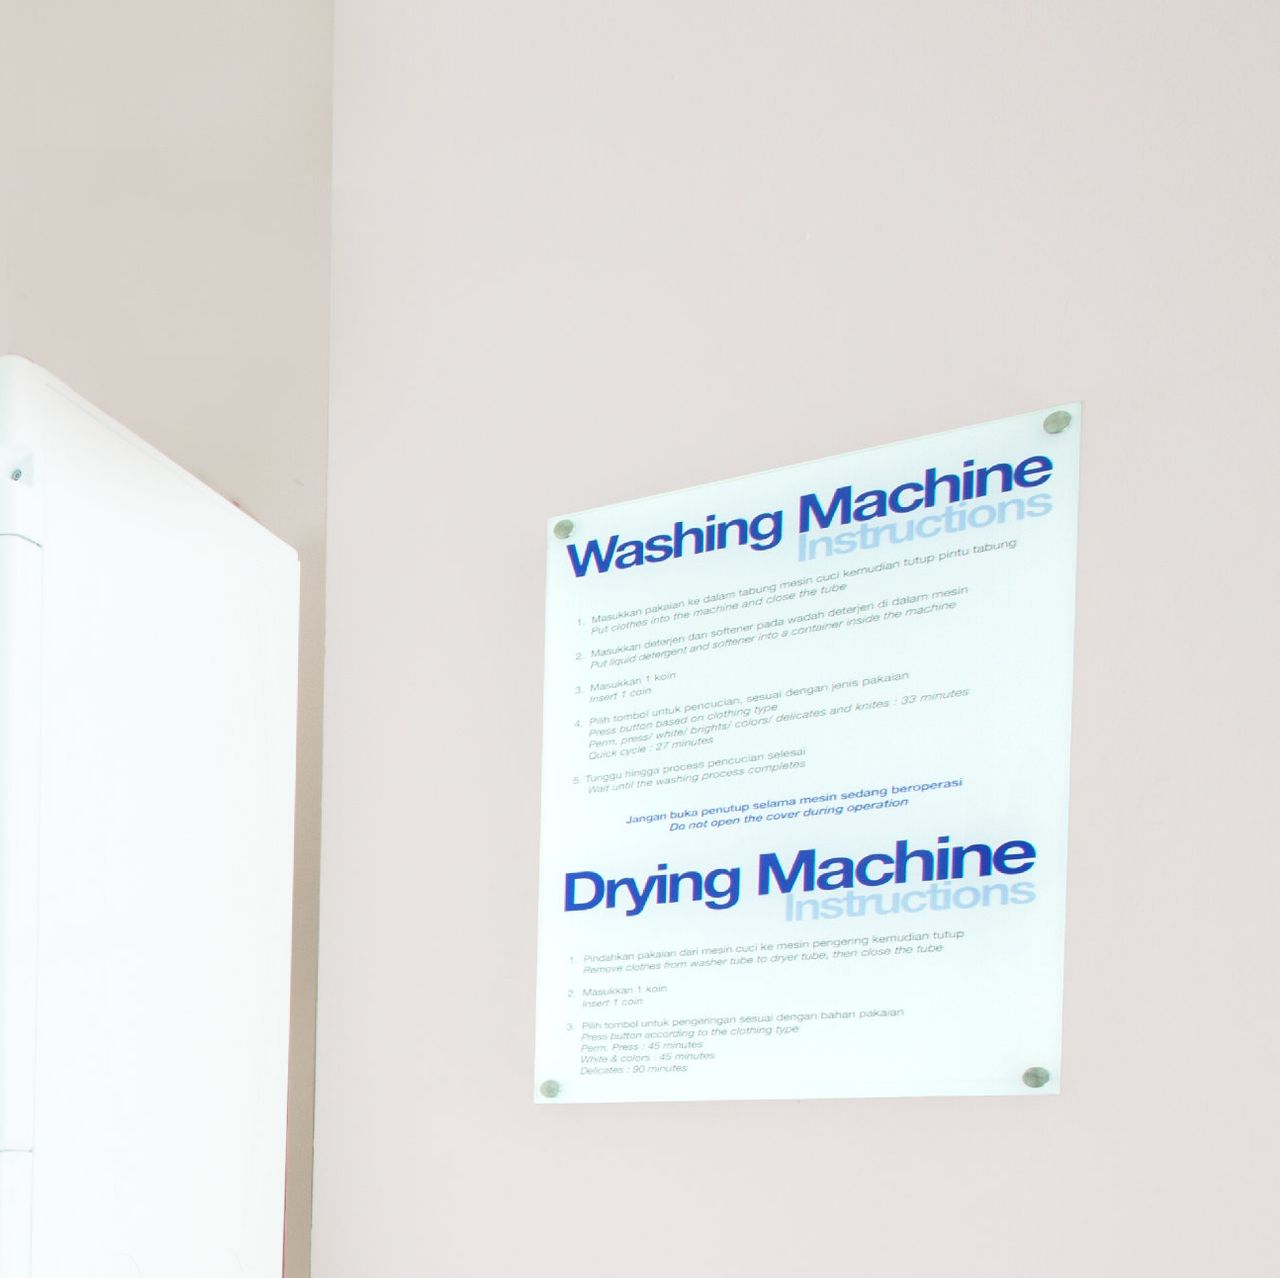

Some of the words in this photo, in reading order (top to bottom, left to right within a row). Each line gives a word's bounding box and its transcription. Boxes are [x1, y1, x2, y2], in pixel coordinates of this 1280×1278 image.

[567, 509, 784, 577] Washing
[799, 454, 1054, 533] Machine
[799, 490, 1053, 561] Instructions
[591, 608, 642, 624] Masukkan
[644, 600, 685, 615] pakaian
[687, 598, 701, 606] ke
[702, 591, 736, 604] dalam
[738, 584, 777, 597] tabung
[779, 576, 813, 589] mesin
[816, 572, 840, 583] cuci
[843, 561, 900, 577] kemudian
[903, 554, 935, 567] tutup
[938, 548, 970, 562] pintu
[972, 539, 1017, 554] tabung
[591, 625, 609, 635] Put
[610, 619, 649, 632] clothes
[650, 615, 671, 625] into
[673, 611, 691, 621] the
[693, 602, 739, 617] machine
[741, 596, 764, 609] and
[765, 592, 796, 604] close
[799, 588, 818, 598] the
[820, 583, 848, 594] tube
[591, 643, 641, 657] Masukkan
[643, 636, 686, 649] deterjen
[688, 632, 708, 642] dan
[710, 623, 754, 638] softener
[756, 618, 785, 631] pada
[787, 611, 825, 625] wadah
[827, 602, 875, 617] deterjen
[891, 593, 929, 606] dalam
[931, 586, 969, 600] mesin
[590, 659, 608, 670] Put
[610, 654, 637, 666] liquid
[638, 646, 688, 661] detergent
[689, 641, 711, 653] and
[712, 635, 756, 649] softener
[757, 631, 779, 641] into
[790, 620, 845, 636] container
[846, 614, 881, 626] inside
[883, 611, 903, 620] the
[904, 601, 958, 616] machine
[589, 692, 618, 703] Insert
[629, 687, 652, 697] coin
[589, 716, 611, 724] Pilih
[613, 710, 649, 722] tombol
[652, 706, 682, 717] untuk
[746, 691, 782, 703] sesuai
[785, 684, 829, 697] dengan
[831, 679, 859, 692] jenis
[862, 672, 910, 687] pakaian
[590, 677, 642, 692] Masukkan
[654, 672, 677, 681] koin
[588, 727, 617, 737] Press
[619, 722, 653, 733] button
[655, 717, 688, 728] based
[690, 715, 705, 723] on
[706, 708, 752, 721] clothing
[754, 704, 778, 715] type
[775, 708, 827, 723] delicates
[829, 703, 853, 715] and
[900, 694, 918, 705] 33
[919, 688, 970, 702] minutes
[585, 773, 623, 783] Tunggu
[624, 767, 660, 778] hingga
[663, 761, 705, 774] process
[707, 754, 764, 769] pencucian
[767, 747, 806, 760] selesai
[588, 750, 617, 760] Quick
[619, 746, 647, 756] cycle
[655, 741, 670, 751] 27
[671, 736, 714, 749] minutes
[588, 785, 610, 794] Wait
[612, 780, 635, 791] until
[636, 780, 653, 789] the
[656, 774, 700, 786] washing
[701, 768, 745, 781] process
[747, 760, 806, 774] completes
[625, 813, 667, 825] Jangan
[669, 809, 699, 820] buka
[701, 804, 750, 818] penutup
[752, 798, 797, 810] selama
[799, 793, 838, 805] mesin
[840, 788, 889, 800] sedang
[891, 777, 964, 795] beroperasi
[669, 822, 686, 832] Do
[688, 819, 709, 830] not
[710, 817, 741, 829] open
[743, 814, 764, 824] the
[765, 810, 802, 822] cover
[802, 806, 845, 817] during
[846, 798, 910, 814] operation
[565, 863, 739, 915] Drying
[759, 835, 1036, 896] Machine
[784, 878, 1036, 922] Instructions
[583, 952, 635, 962] Pindahkan
[637, 950, 676, 961] pakaian
[679, 949, 699, 957] dari
[701, 946, 733, 955] mesin
[735, 945, 758, 953] cuci
[760, 943, 775, 951] ke
[776, 941, 810, 950] mesin
[812, 937, 869, 949] pengering
[871, 932, 930, 944] kemudian
[933, 930, 965, 940] tutup
[583, 965, 624, 974] Remove
[625, 963, 661, 972] clothes
[663, 961, 688, 969] from
[690, 958, 728, 968] washer
[729, 957, 754, 965] tube
[756, 955, 768, 963] to
[769, 953, 799, 963] dryer
[833, 950, 858, 958] then
[860, 948, 892, 957] close
[894, 946, 914, 955] the
[916, 944, 945, 953] tube
[582, 987, 633, 997] Masukkan
[645, 985, 668, 993] koin
[582, 999, 610, 1008] Insert
[622, 998, 644, 1006] coin
[581, 1032, 608, 1041] Press
[610, 1032, 642, 1040] button
[644, 1030, 695, 1039] according
[711, 1028, 728, 1036] the
[730, 1026, 773, 1036] clothing
[775, 1025, 800, 1036] type
[604, 1019, 639, 1029] tombol
[640, 1019, 669, 1028] untuk
[672, 1017, 736, 1027] pengeringan
[739, 1015, 774, 1024] sesuai
[776, 1013, 818, 1023] dengan
[820, 1011, 856, 1020] bahan
[859, 1008, 905, 1019] pakaian
